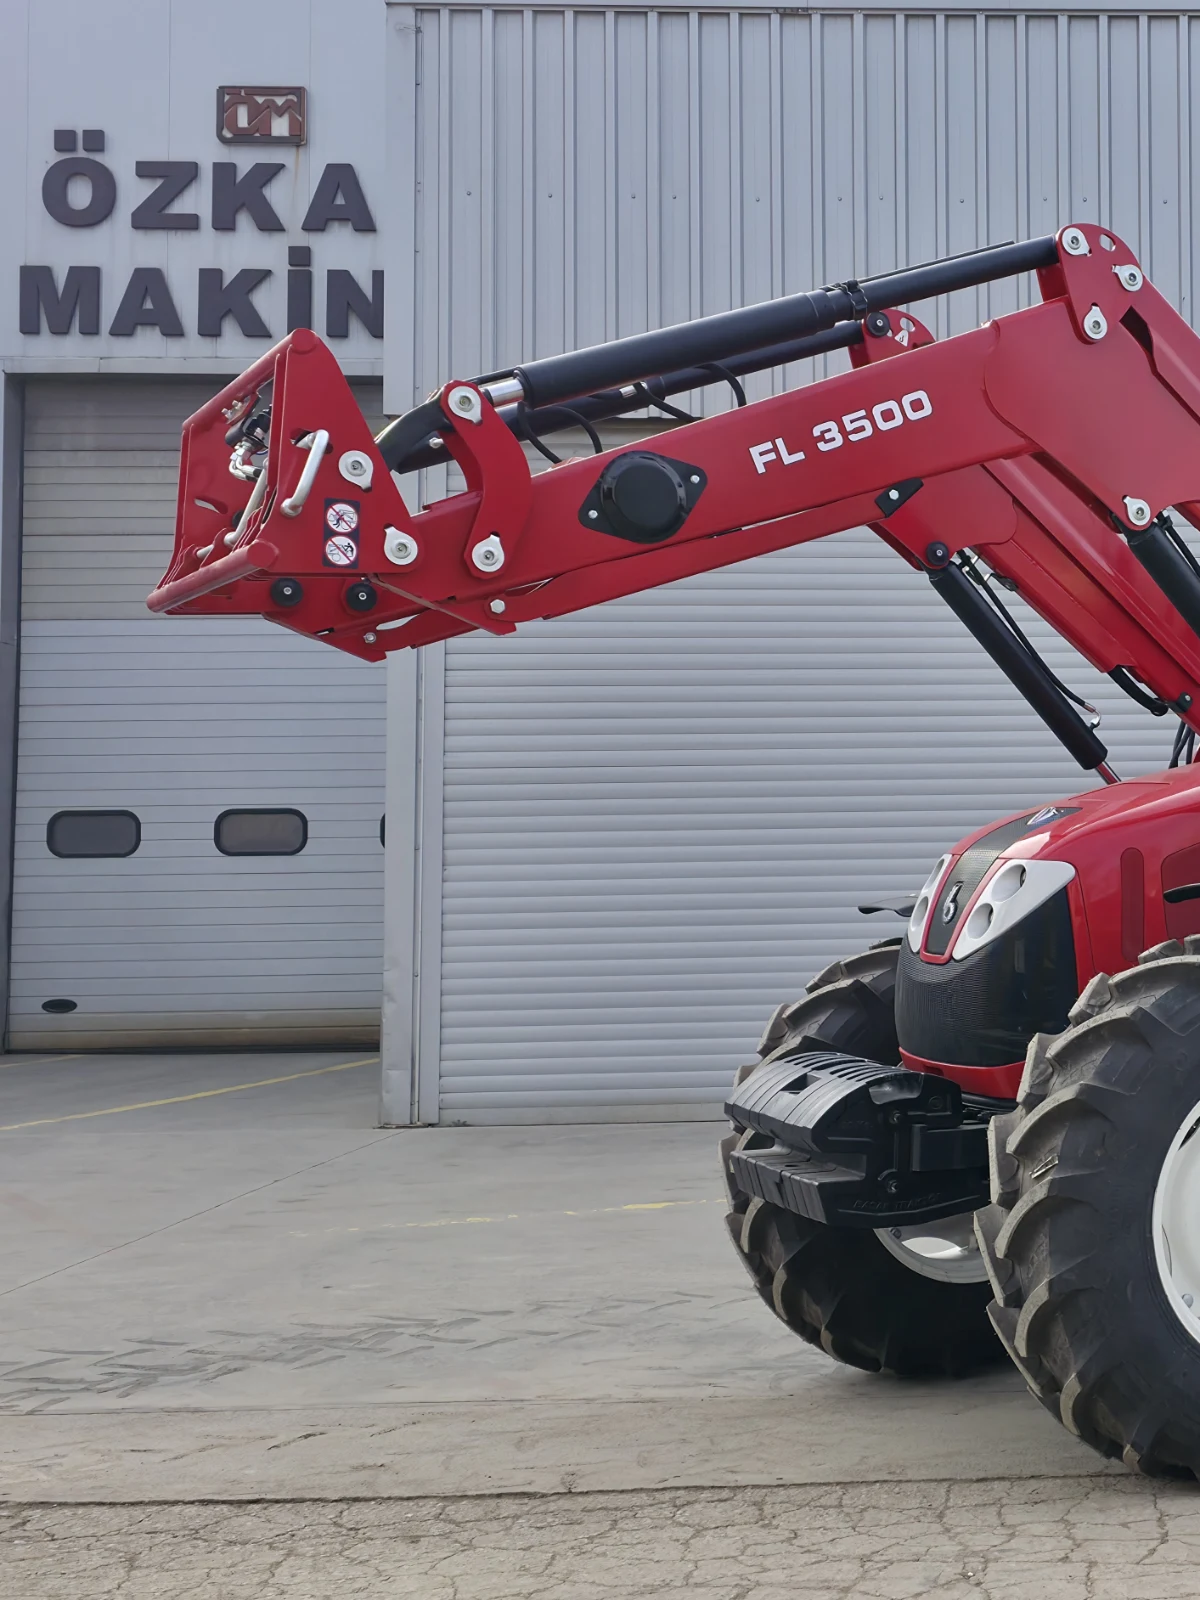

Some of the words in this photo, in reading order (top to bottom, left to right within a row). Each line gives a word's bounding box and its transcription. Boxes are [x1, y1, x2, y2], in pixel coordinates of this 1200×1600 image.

[41, 129, 377, 232] ÖZKA
[19, 245, 384, 339] MAKİN
[749, 437, 806, 474] FL
[812, 390, 933, 452] 3500
